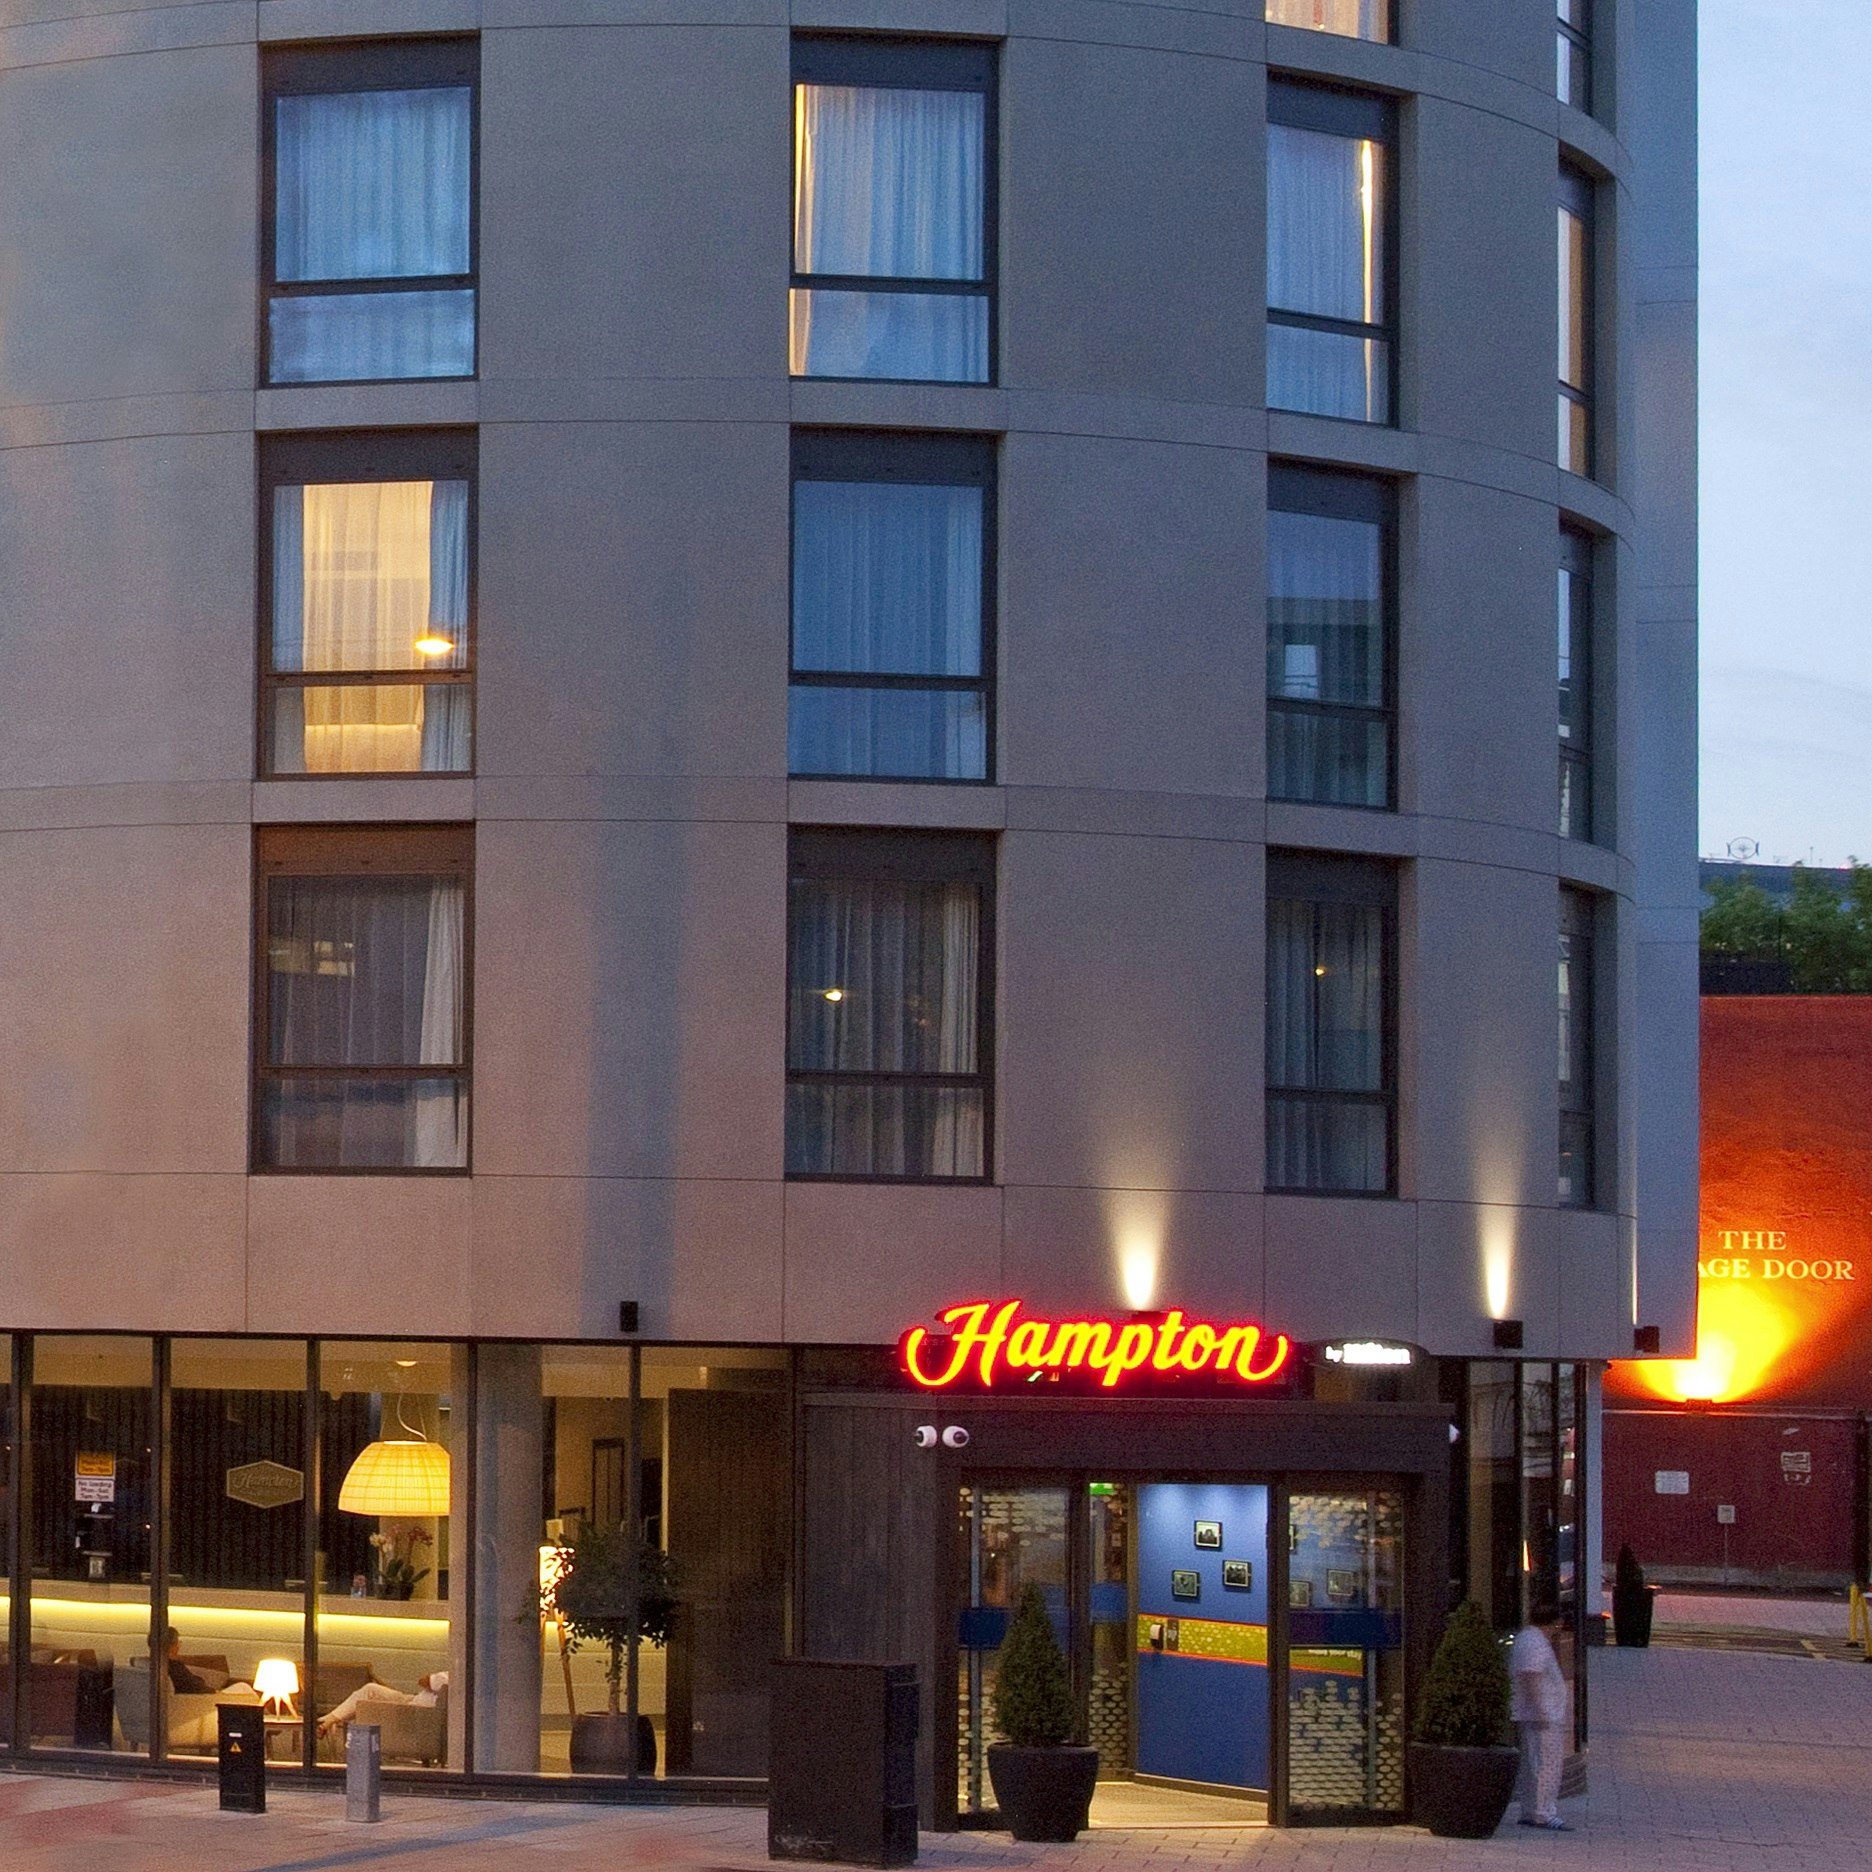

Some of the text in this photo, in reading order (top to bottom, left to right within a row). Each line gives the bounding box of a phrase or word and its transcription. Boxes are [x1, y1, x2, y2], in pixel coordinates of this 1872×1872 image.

[1718, 1230, 1787, 1250] THE
[1697, 1258, 1854, 1280] AGE DOOR
[905, 1299, 1289, 1388] Hampton
